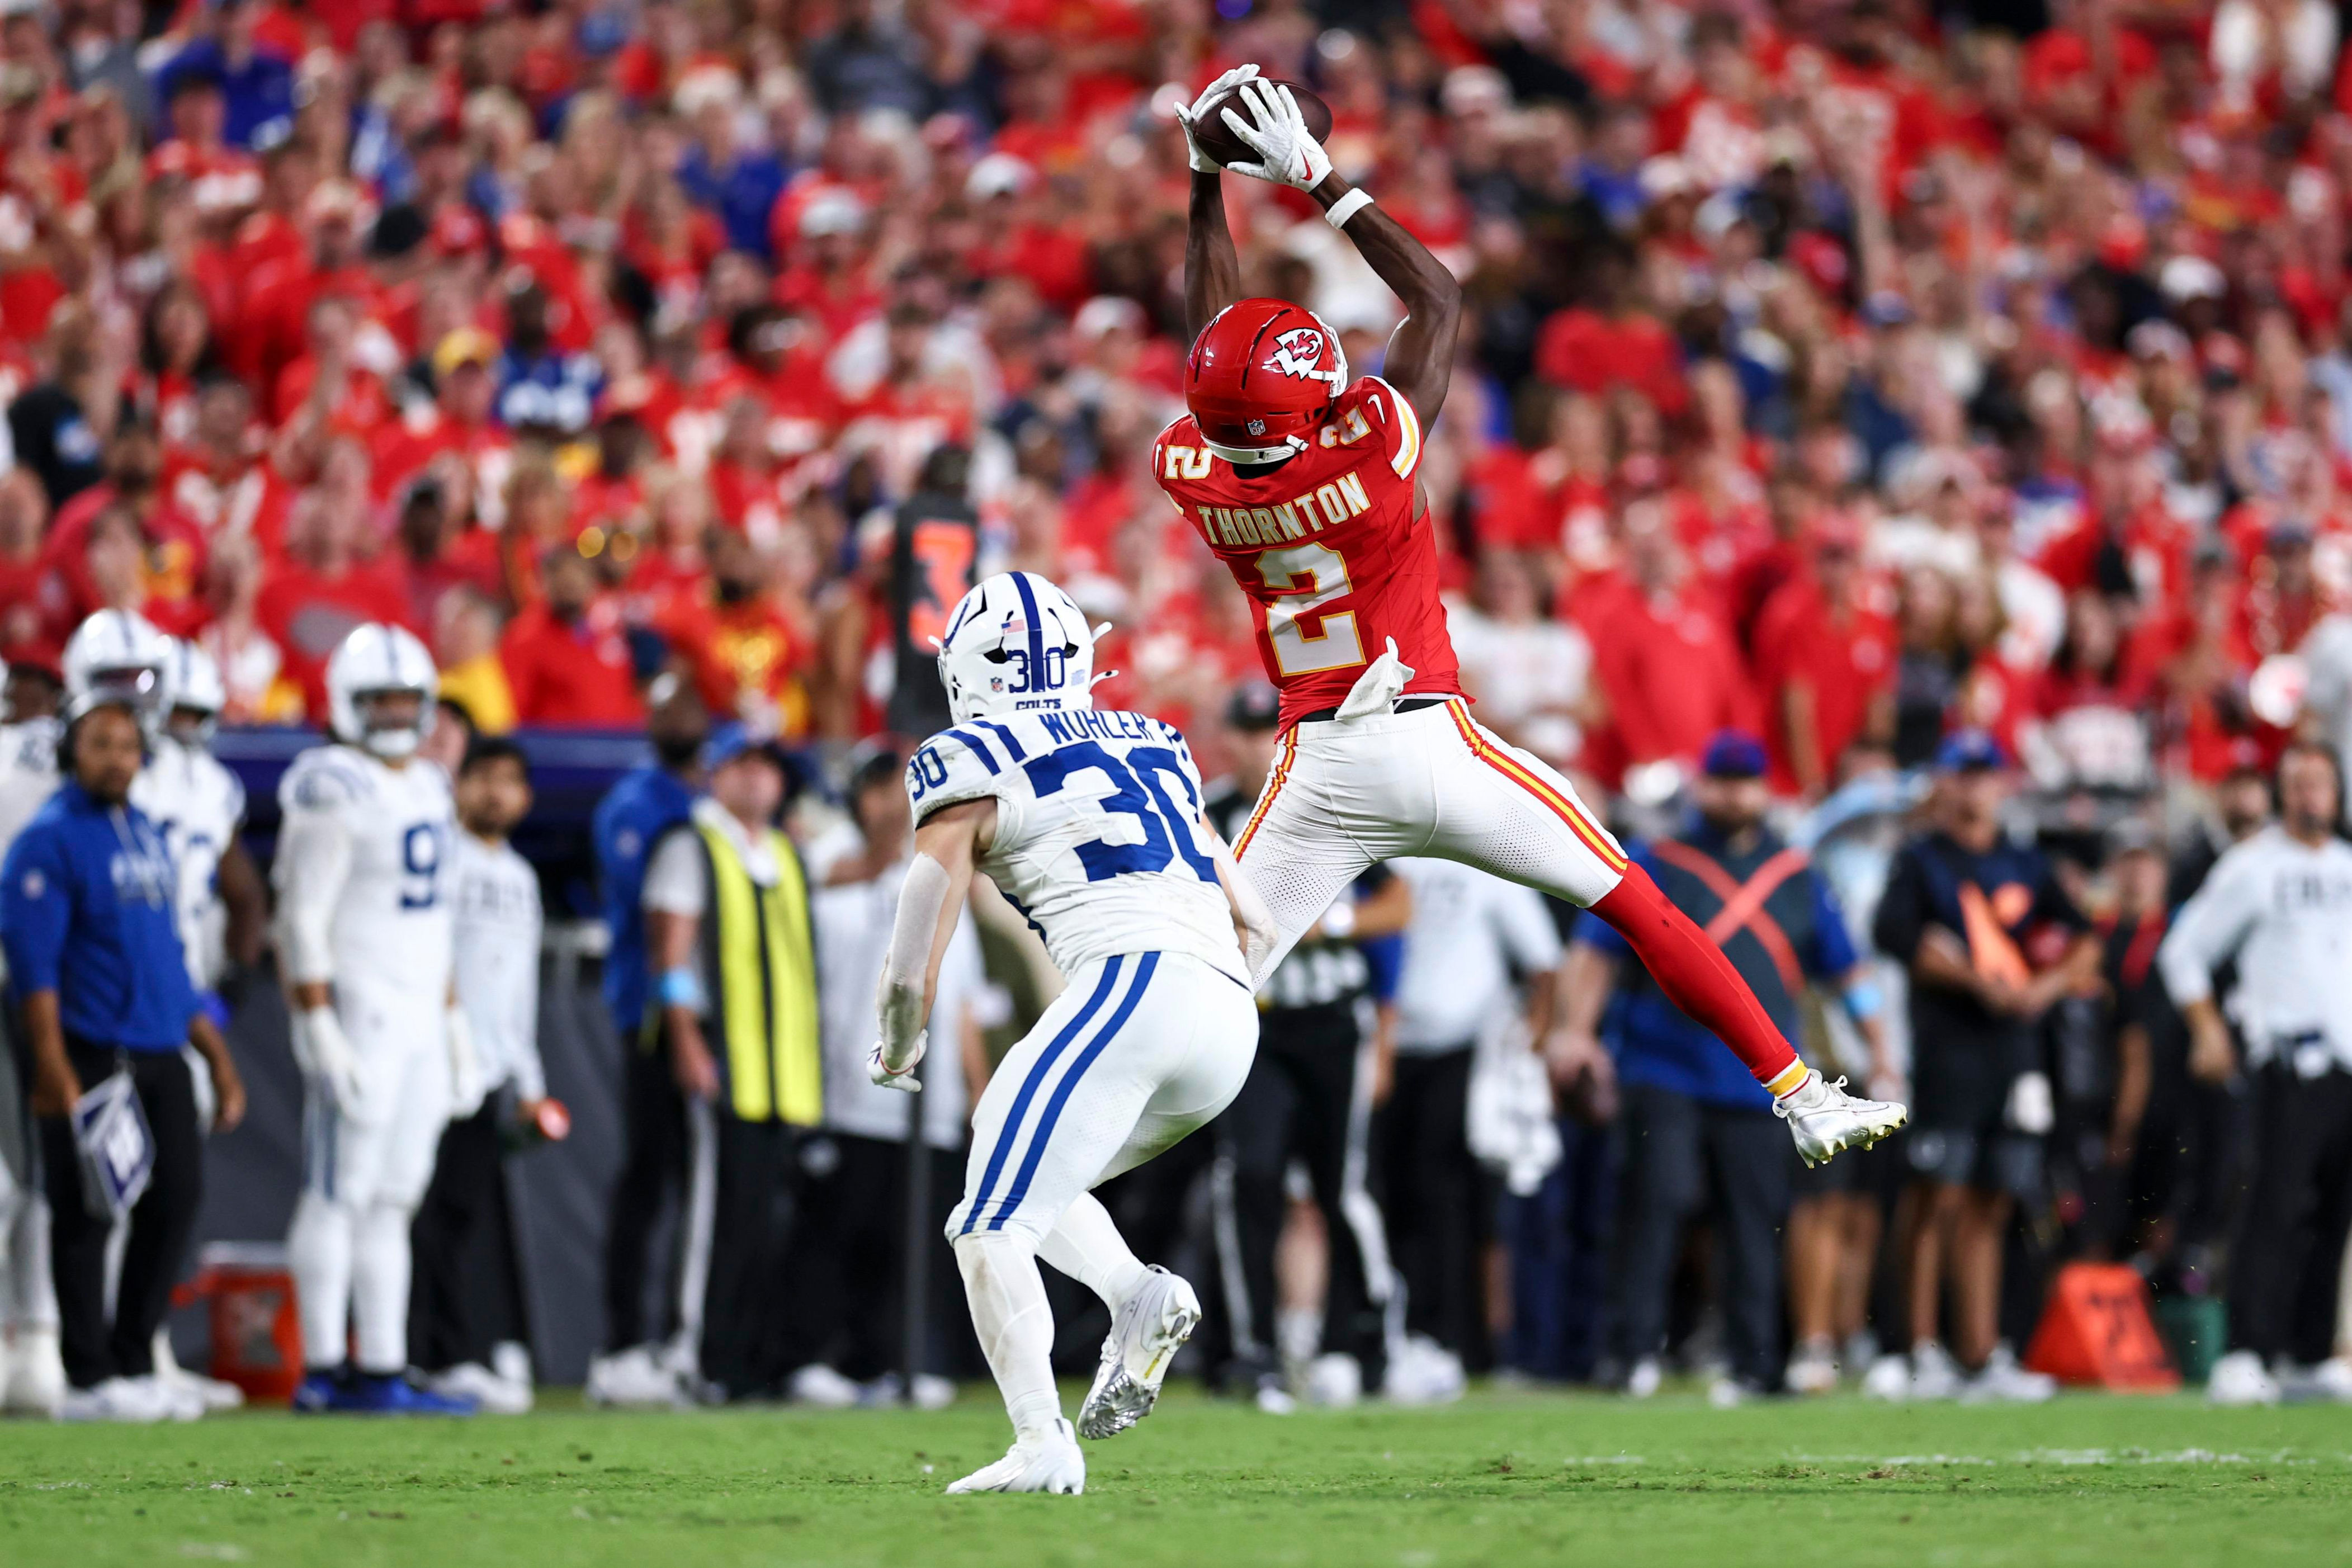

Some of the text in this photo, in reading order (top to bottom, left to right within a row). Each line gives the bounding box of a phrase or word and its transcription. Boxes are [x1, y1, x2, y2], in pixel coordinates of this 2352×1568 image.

[1319, 404, 1372, 448] 2
[1164, 445, 1213, 480] 2
[1197, 471, 1371, 546] THORNTON
[910, 520, 975, 653] 3
[1254, 541, 1367, 678] 2
[1007, 646, 1065, 693] 30
[1016, 698, 1061, 710] COLTS
[1037, 710, 1155, 744] WOHLER
[909, 746, 948, 802] 30
[1023, 741, 1222, 888] 30
[400, 820, 440, 910] 9
